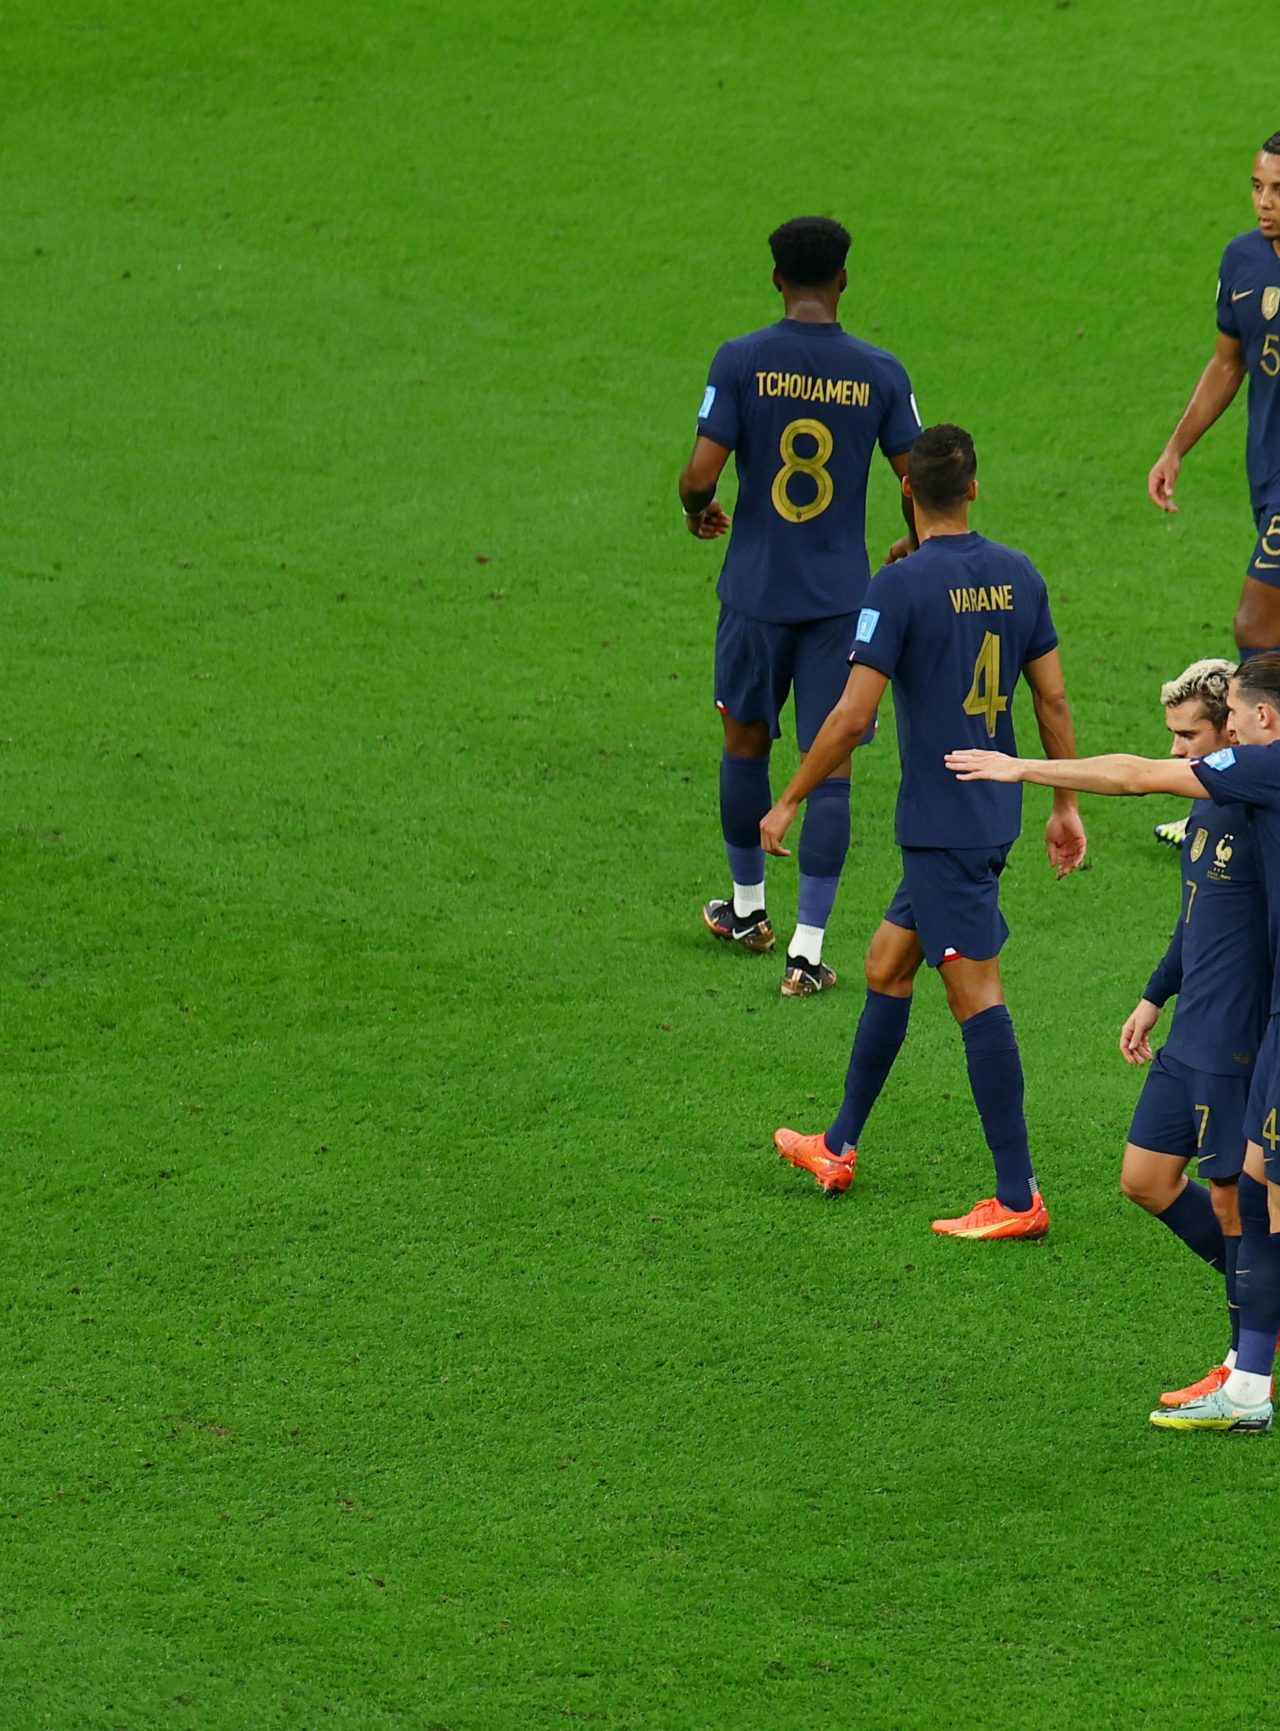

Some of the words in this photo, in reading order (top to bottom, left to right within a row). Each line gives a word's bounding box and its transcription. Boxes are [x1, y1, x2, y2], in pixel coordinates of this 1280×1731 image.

[756, 371, 870, 407] TCHOUAMENI
[771, 418, 834, 524] 8
[949, 585, 1014, 614] VARANE
[962, 630, 1009, 738] 4
[1185, 879, 1198, 924] 7
[1195, 1104, 1211, 1149] 7
